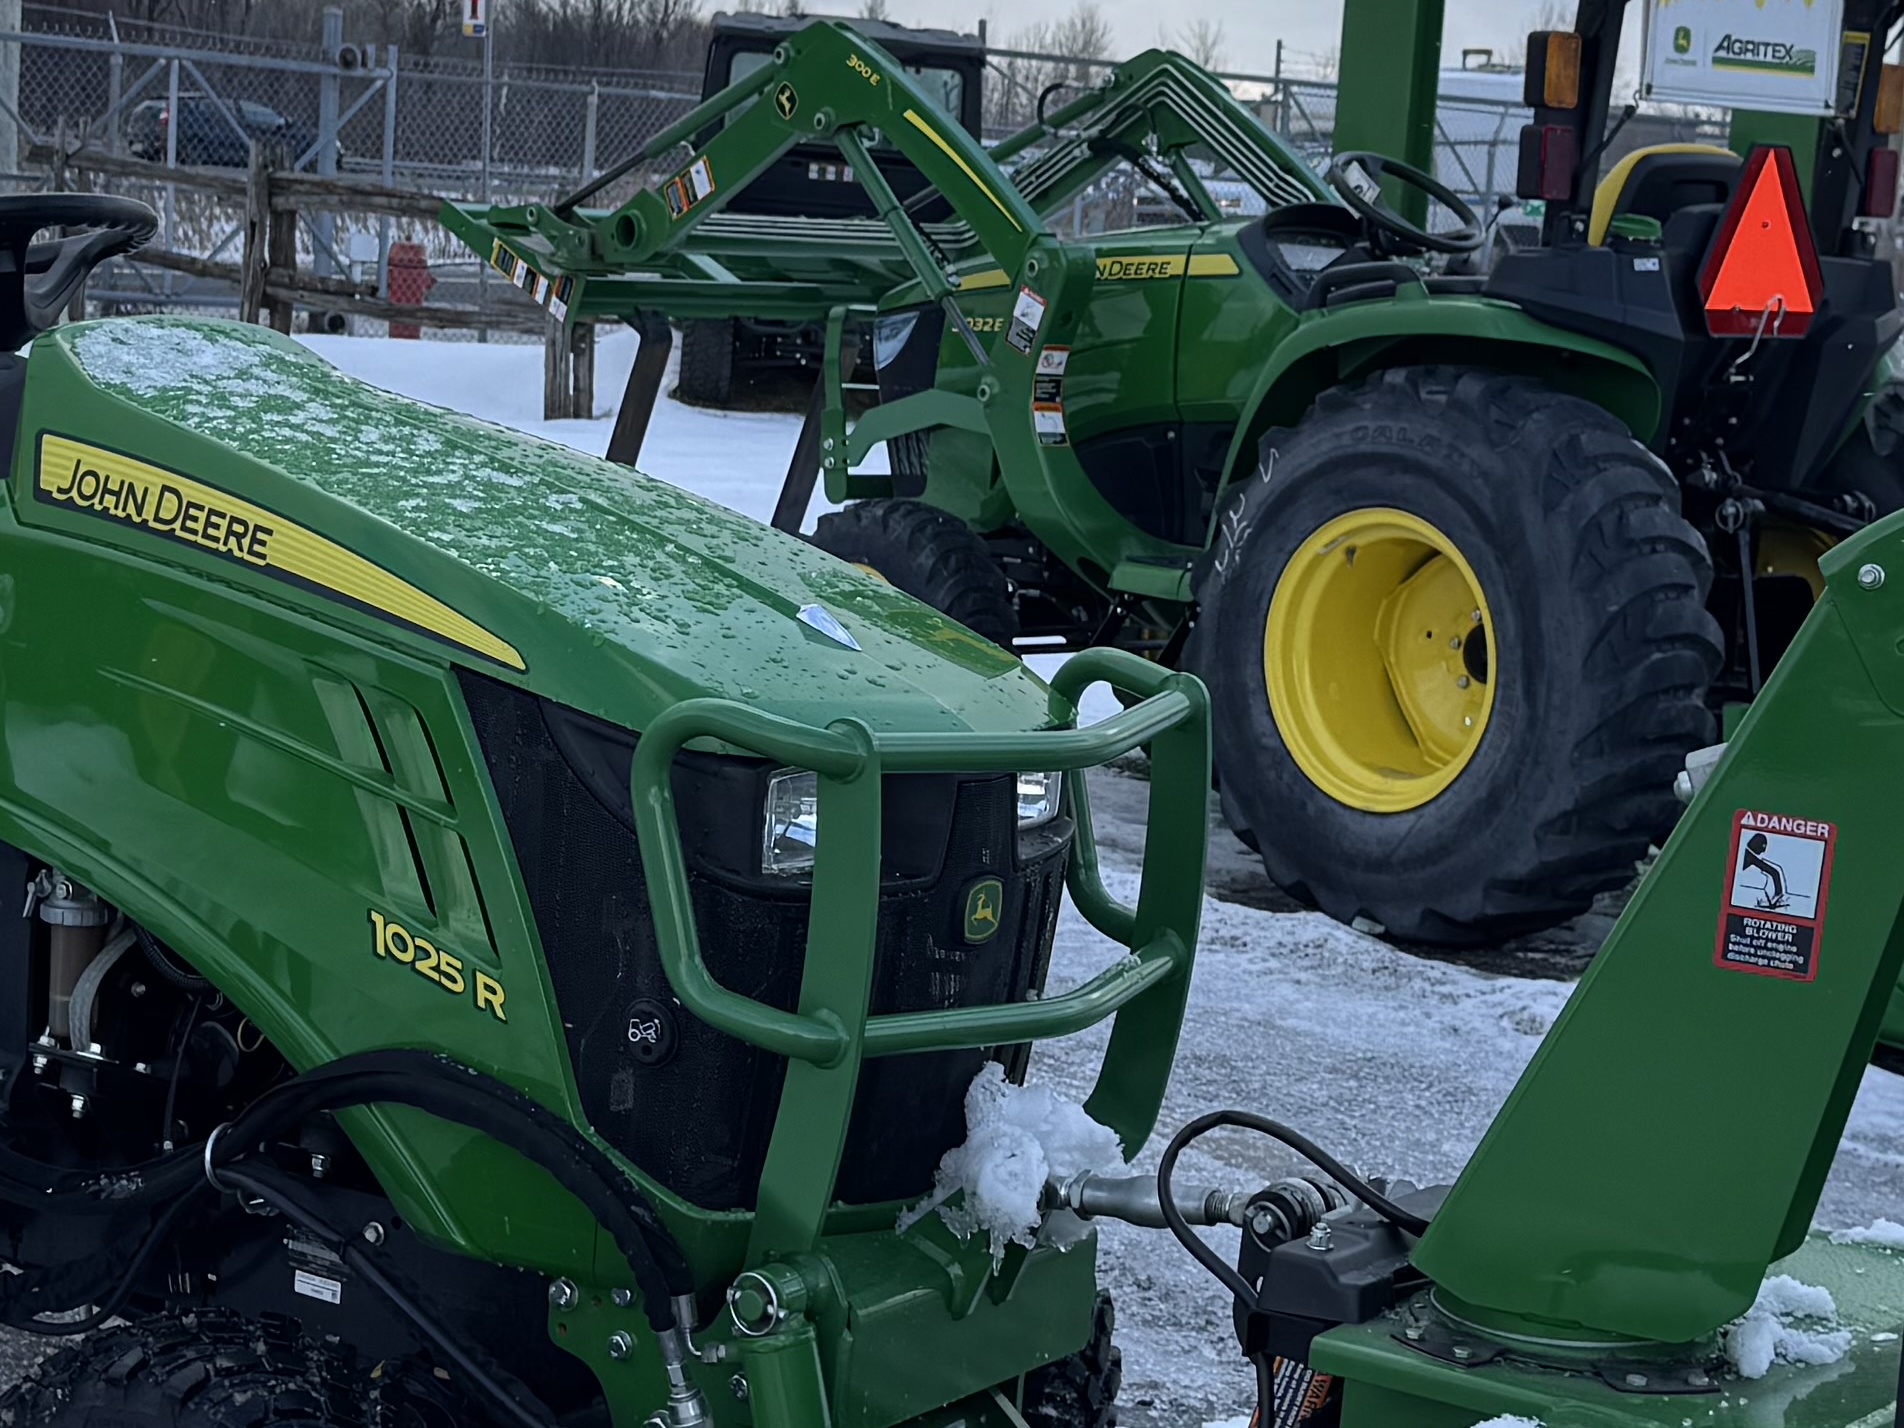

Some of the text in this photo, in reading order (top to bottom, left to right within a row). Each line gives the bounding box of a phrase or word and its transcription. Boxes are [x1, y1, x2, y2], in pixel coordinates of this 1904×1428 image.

[1713, 34, 1795, 62] AGRITEX
[1107, 260, 1172, 278] DEERE
[951, 316, 1004, 332] 032E
[56, 458, 275, 564] JOHN DEERE
[1756, 813, 1830, 839] DANGER
[1743, 917, 1797, 934] ROTATING
[1745, 926, 1793, 943] BLOWER
[368, 909, 509, 1023] 1025 R
